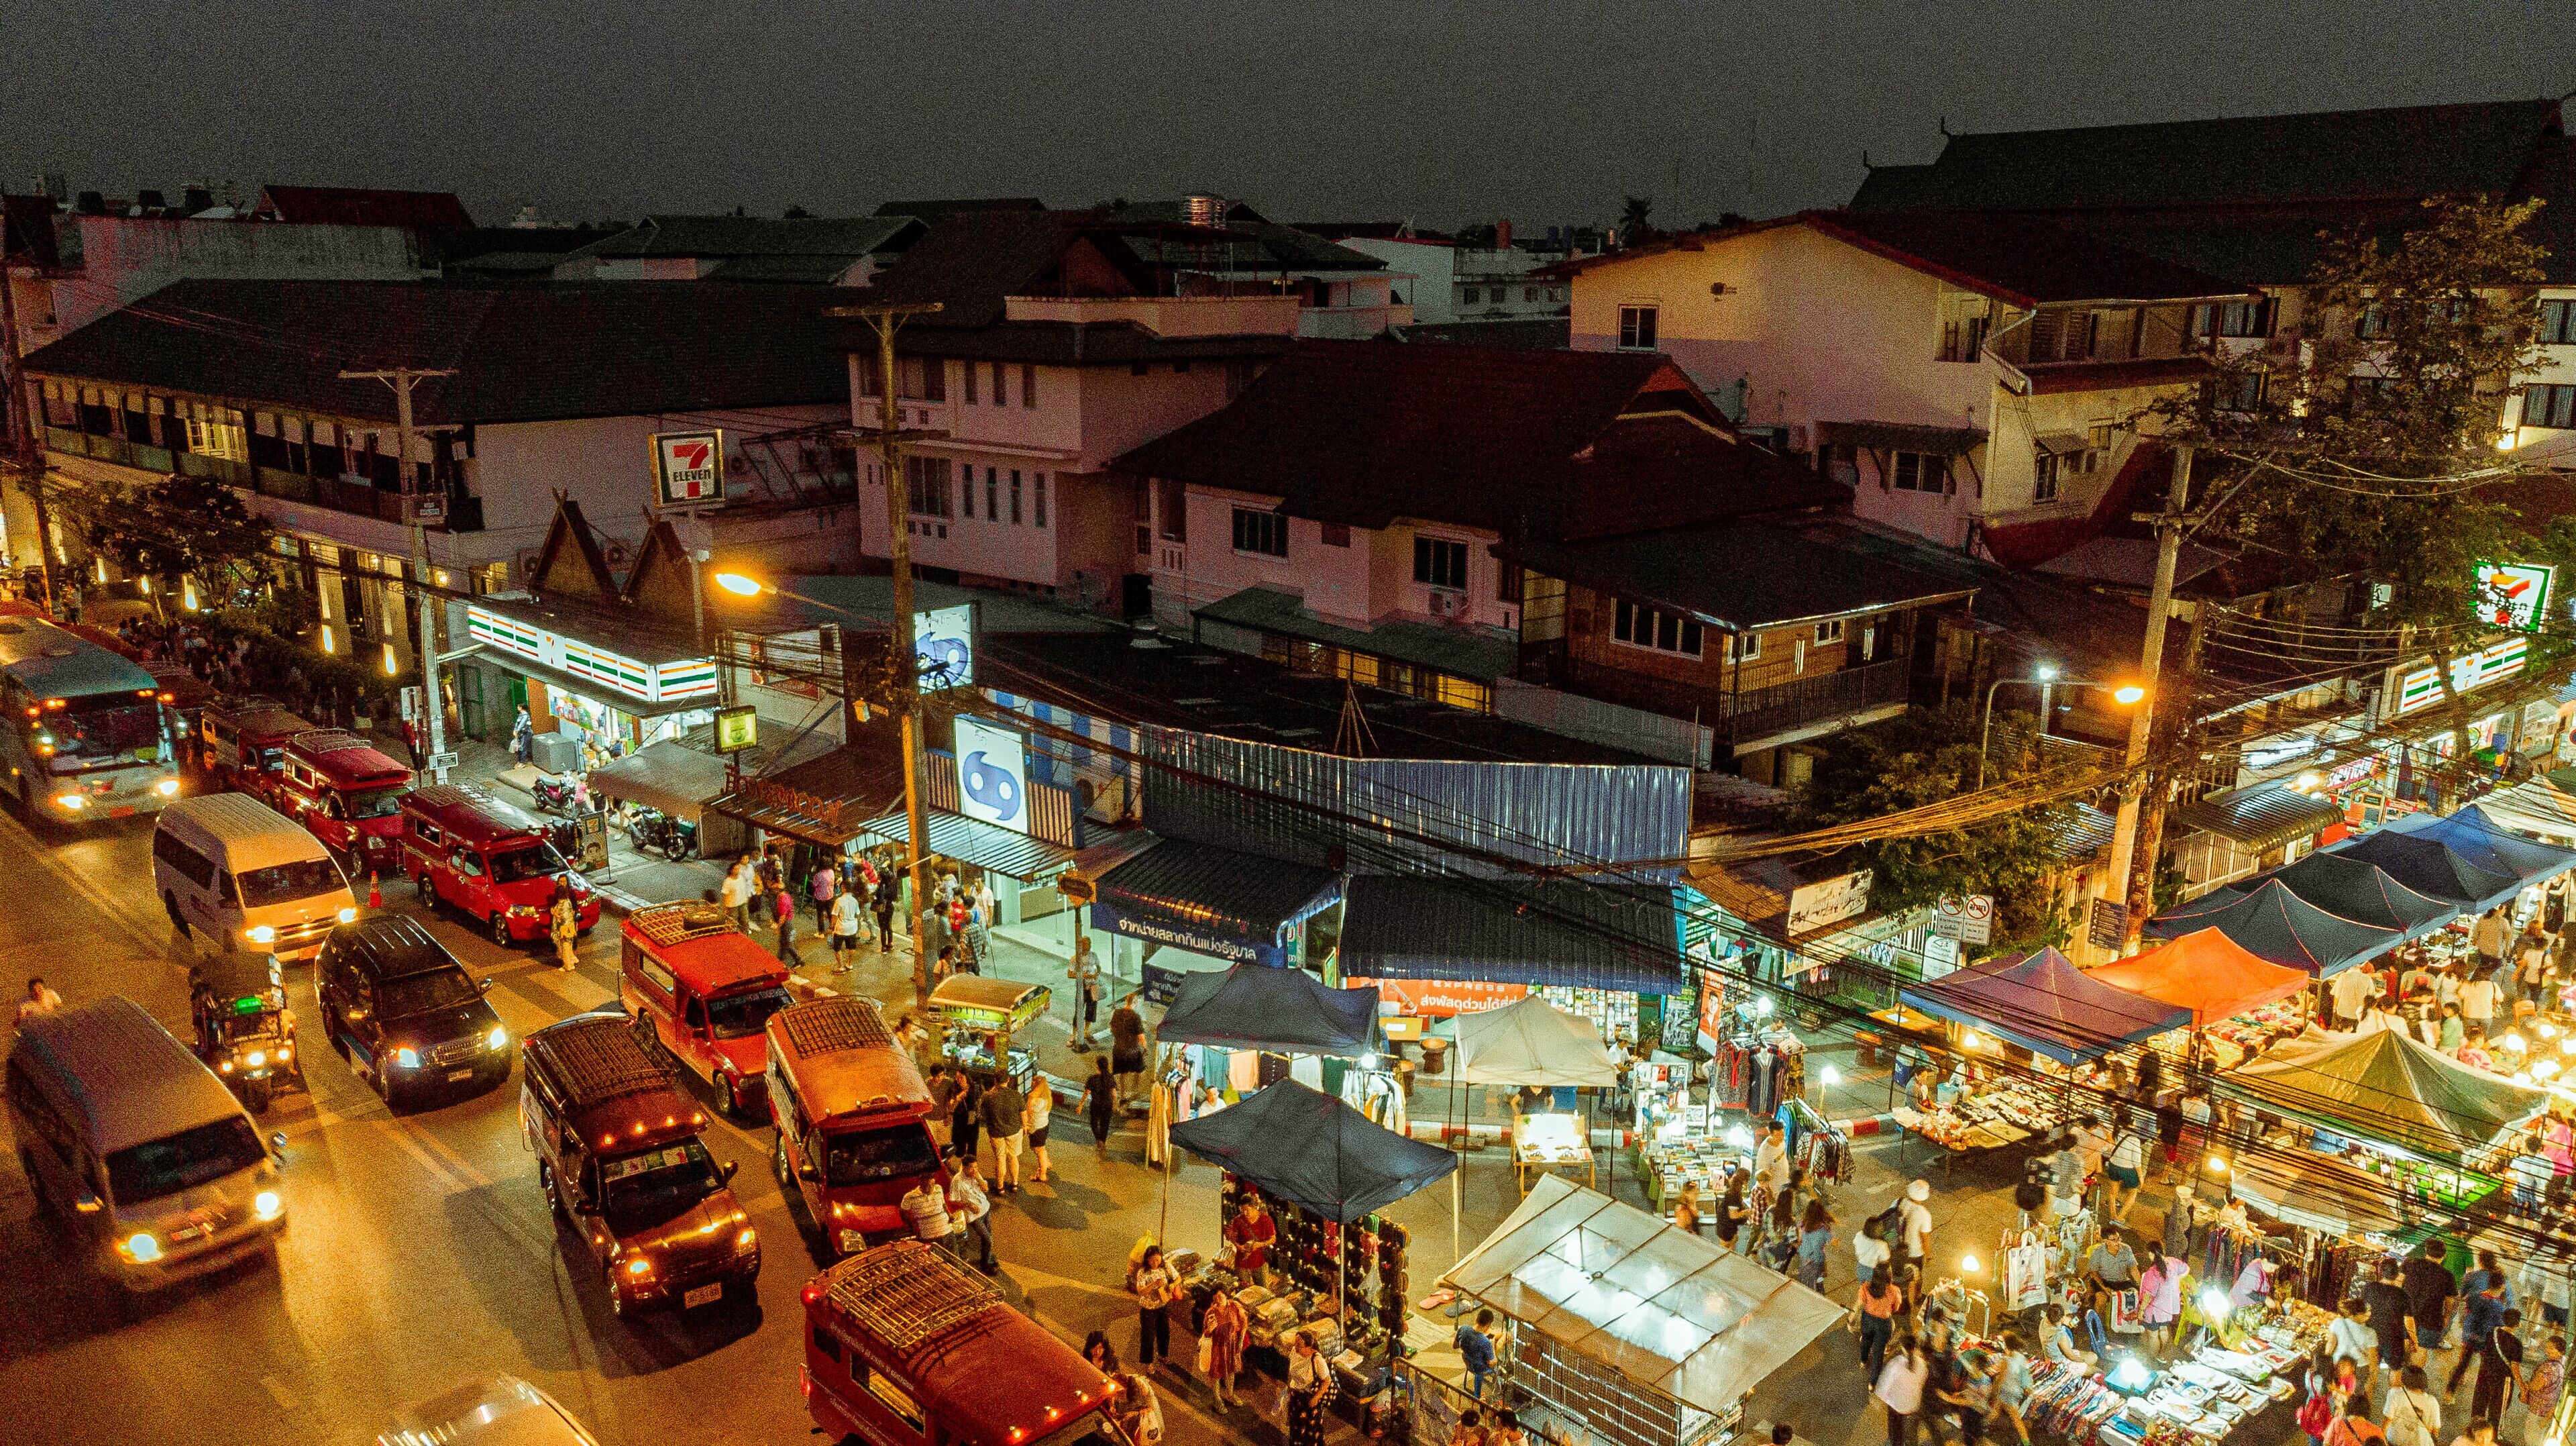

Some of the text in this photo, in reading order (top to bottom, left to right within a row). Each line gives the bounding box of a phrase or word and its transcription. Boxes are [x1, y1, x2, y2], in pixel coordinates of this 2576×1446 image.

[673, 441, 708, 497] 7
[2490, 574, 2530, 625] 7
[1119, 917, 1257, 960] จำหน่ายสลากกินแบ่งรัฐบาล
[1433, 980, 1506, 992] EXPRESS
